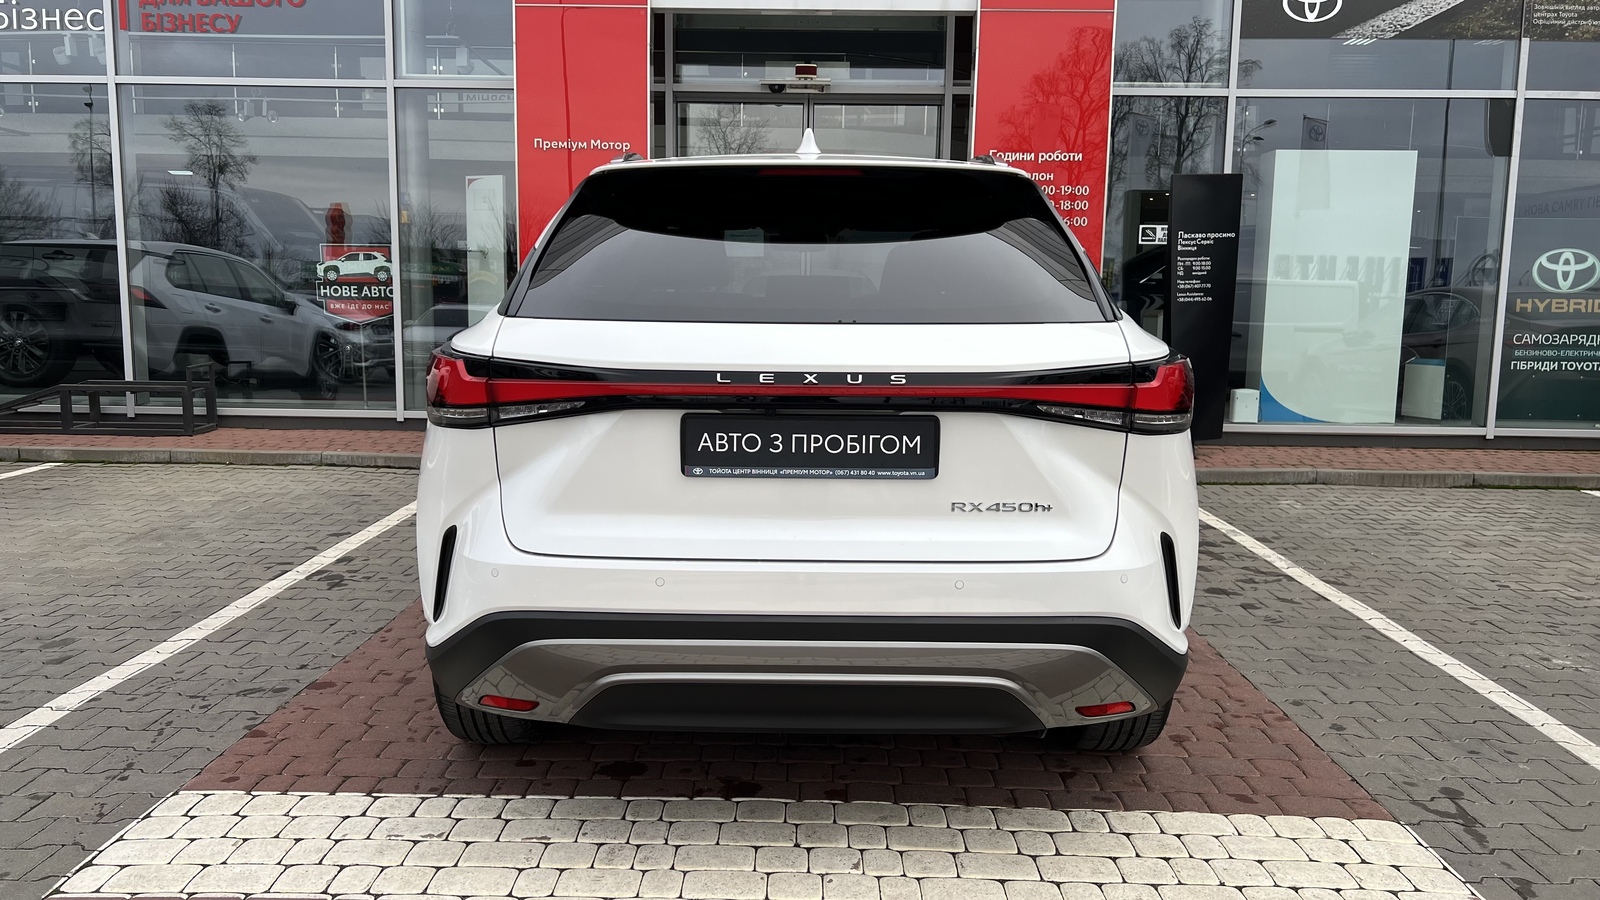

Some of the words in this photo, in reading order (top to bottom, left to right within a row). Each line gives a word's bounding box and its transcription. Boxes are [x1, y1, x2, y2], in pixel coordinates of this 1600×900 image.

[141, 13, 241, 33] БІЗНЕСУ
[534, 138, 587, 151] Преміум
[590, 139, 631, 152] Мотор
[989, 150, 1035, 162] Години
[1038, 150, 1083, 163] роботи
[1524, 203, 1549, 216] НОВА
[1552, 197, 1586, 213] CAMRY
[1177, 231, 1206, 239] Ласкаво
[320, 285, 358, 297] НОВЕ
[361, 286, 394, 297] АВТО
[1513, 333, 1600, 346] САМОЗАРЯД
[1514, 349, 1600, 357] БЕНЗИНОВО-ЕЛЕКТРИЧ
[1510, 361, 1558, 371] ГІБРИДИ
[1560, 361, 1600, 371] TOYOT
[716, 372, 907, 384] LEXUS
[697, 432, 762, 453] АВТО
[768, 433, 783, 453] З
[791, 434, 921, 455] ПРОБІГОМ
[835, 469, 850, 477] (067)
[877, 470, 926, 478] www.toyota.vn.ua
